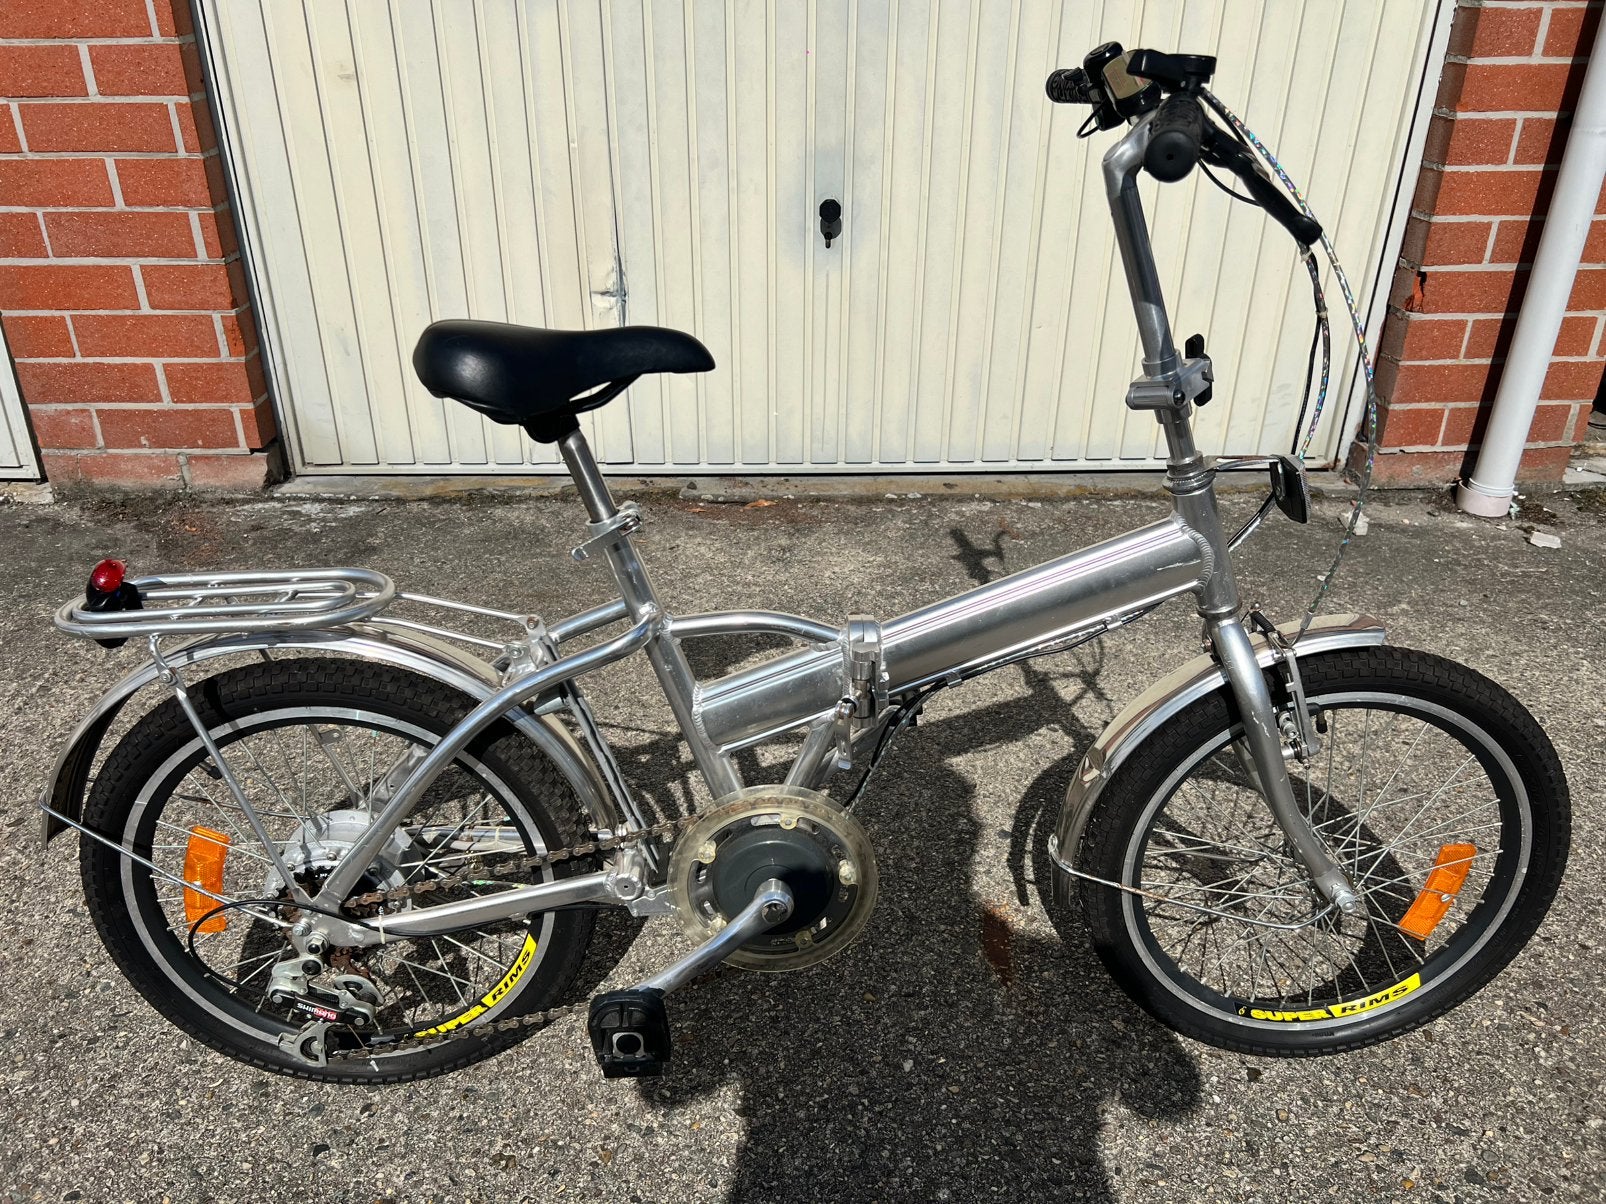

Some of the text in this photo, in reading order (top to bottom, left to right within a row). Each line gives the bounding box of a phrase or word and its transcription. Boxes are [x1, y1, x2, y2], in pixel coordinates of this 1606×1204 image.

[491, 949, 531, 1002] RIMS
[1250, 985, 1408, 1022] SUPER RIMS
